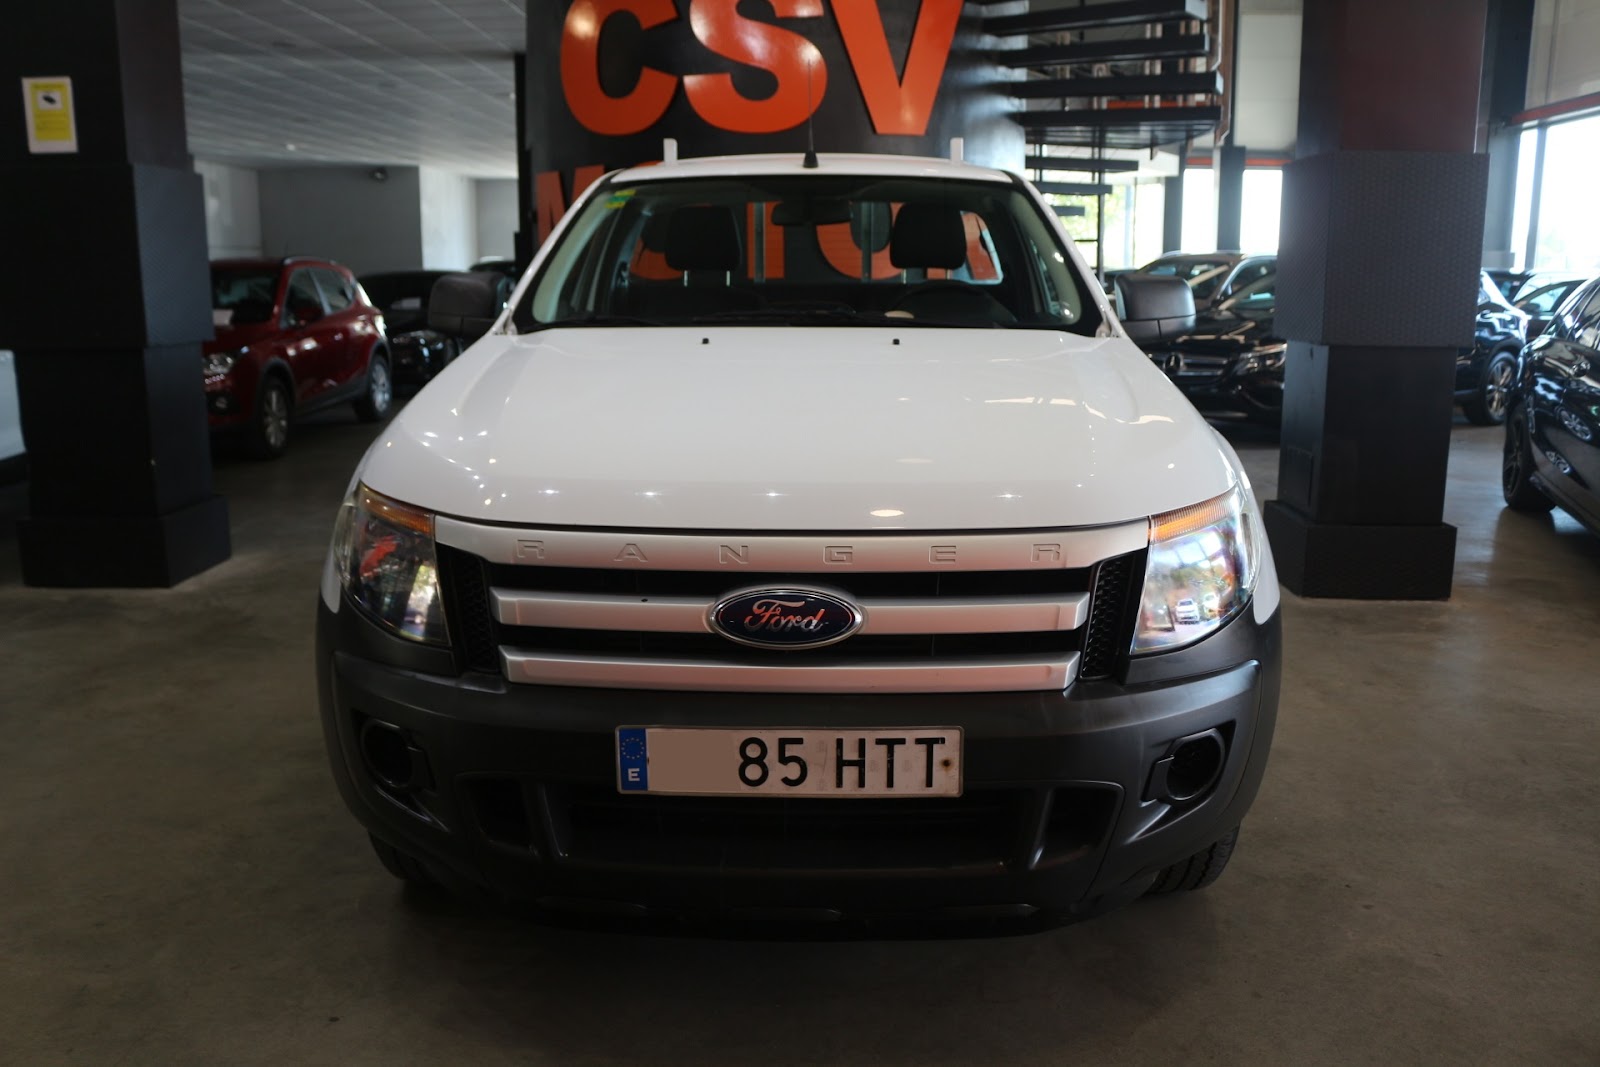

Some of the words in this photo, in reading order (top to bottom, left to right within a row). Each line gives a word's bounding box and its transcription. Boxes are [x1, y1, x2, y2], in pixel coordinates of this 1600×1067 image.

[560, 0, 964, 135] CSV
[516, 539, 1061, 564] RANGER
[744, 599, 825, 632] Ford
[628, 768, 640, 781] E
[738, 737, 808, 787] 85
[836, 737, 946, 789] HTT
